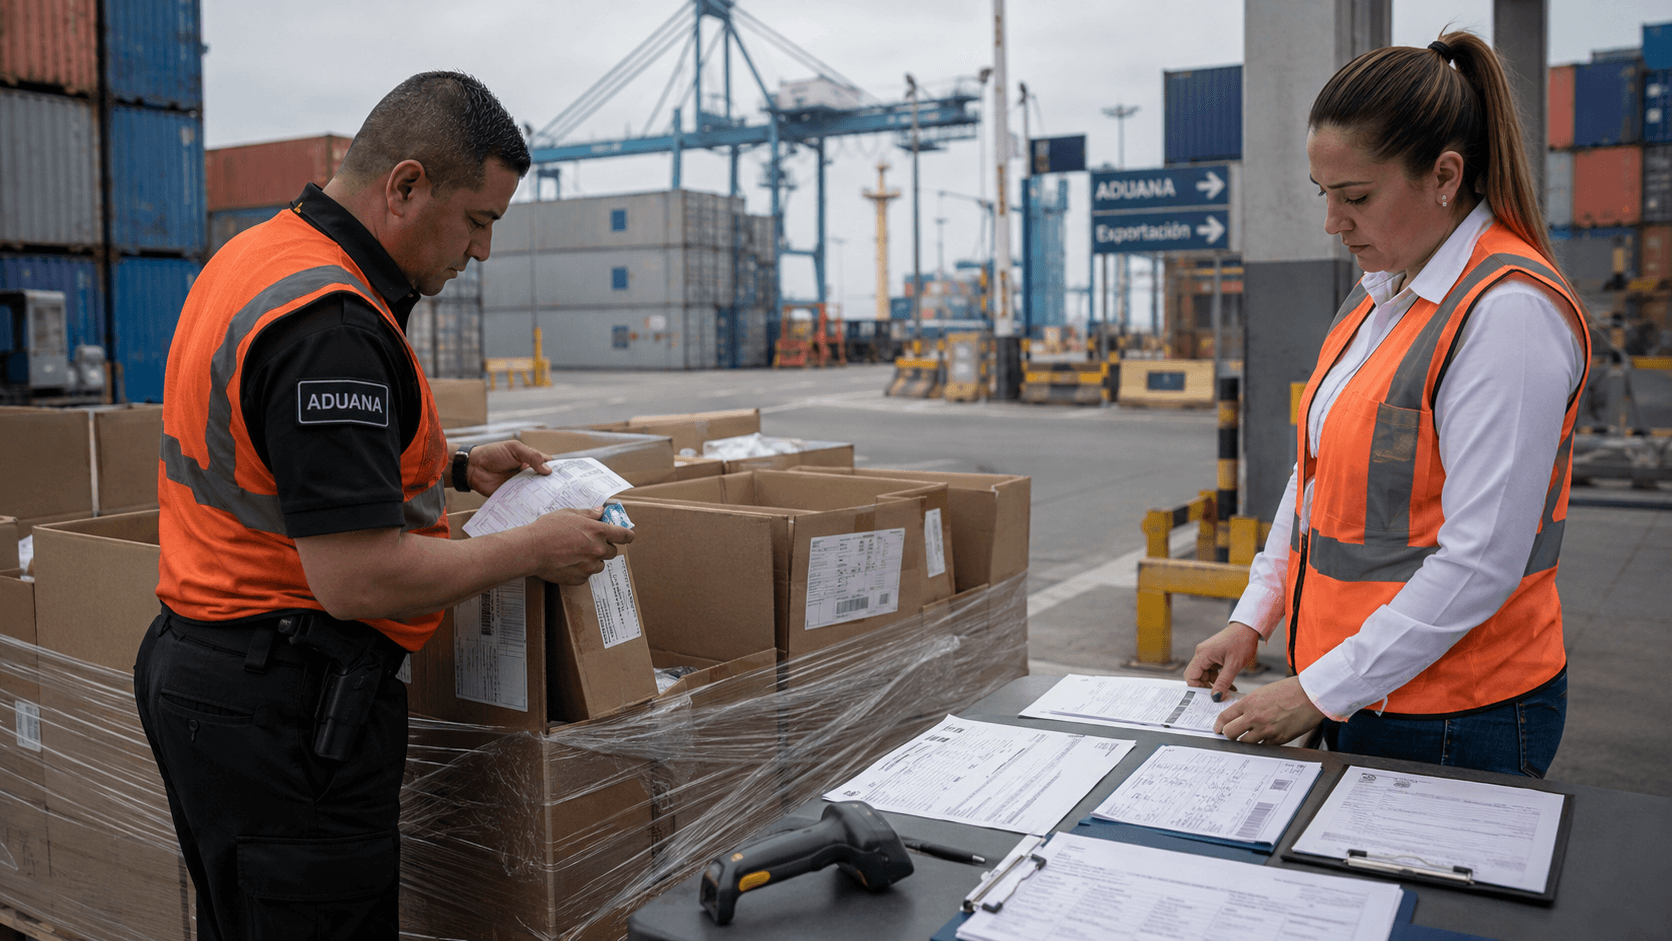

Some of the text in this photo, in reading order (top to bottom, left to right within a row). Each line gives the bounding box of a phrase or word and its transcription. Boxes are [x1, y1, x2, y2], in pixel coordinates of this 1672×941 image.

[1095, 178, 1176, 201] ADUANA
[1096, 221, 1191, 244] Exportación
[307, 393, 382, 413] ADUANA
